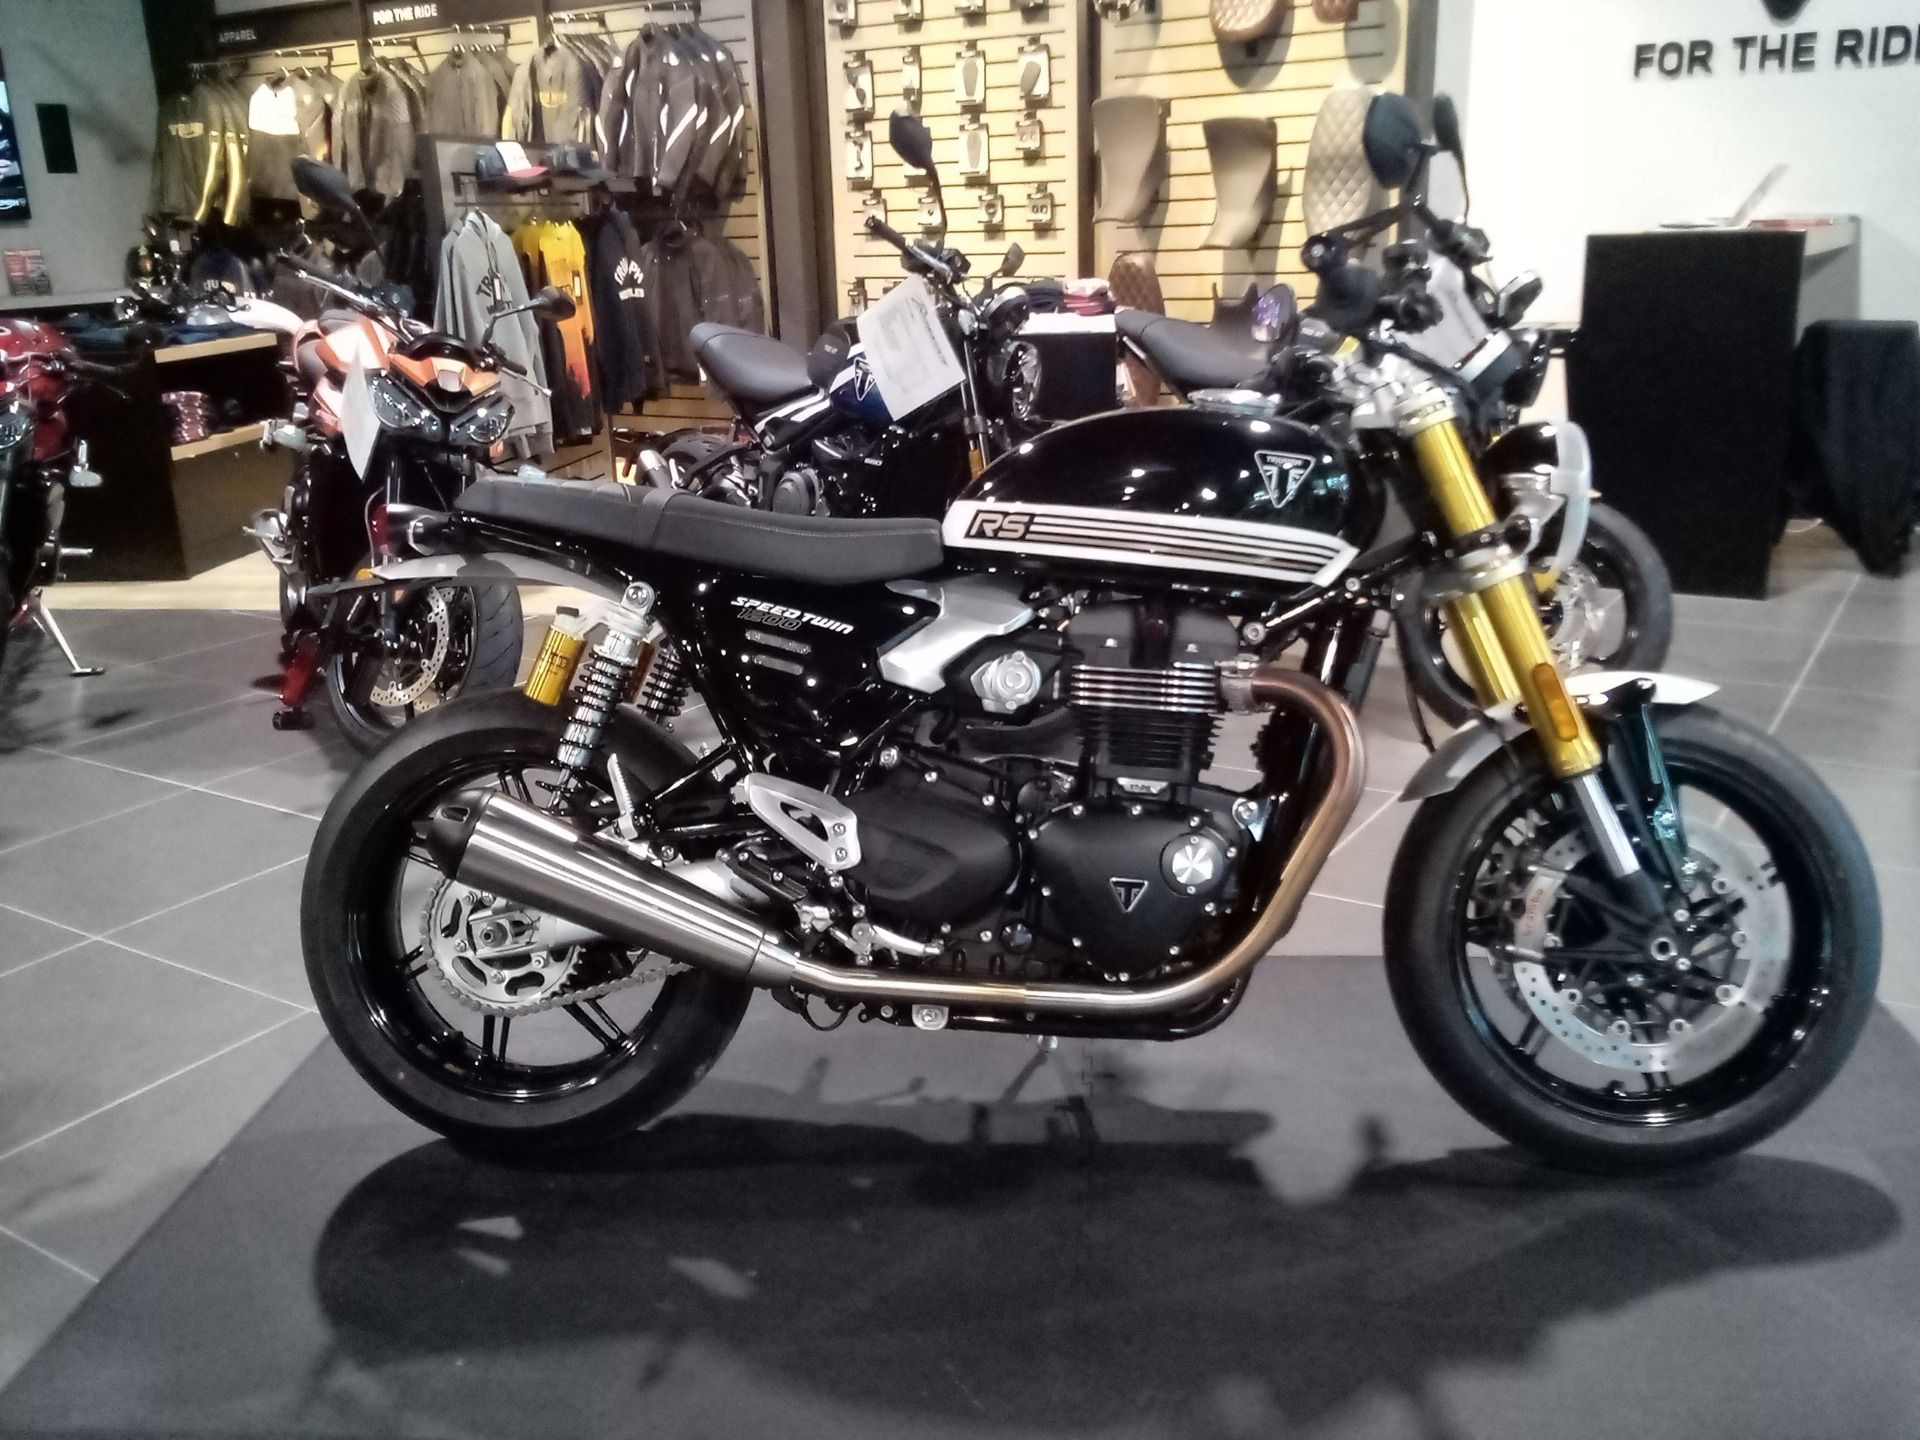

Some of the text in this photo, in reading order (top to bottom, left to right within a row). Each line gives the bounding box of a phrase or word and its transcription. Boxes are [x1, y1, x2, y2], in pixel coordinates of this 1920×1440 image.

[373, 4, 438, 25] FOR THE RIDE
[218, 29, 257, 43] APPAREL
[1634, 24, 1920, 80] FOR THE RID
[966, 510, 1031, 539] RS
[730, 596, 855, 635] SPEED TWIN
[737, 607, 802, 631] 1200
